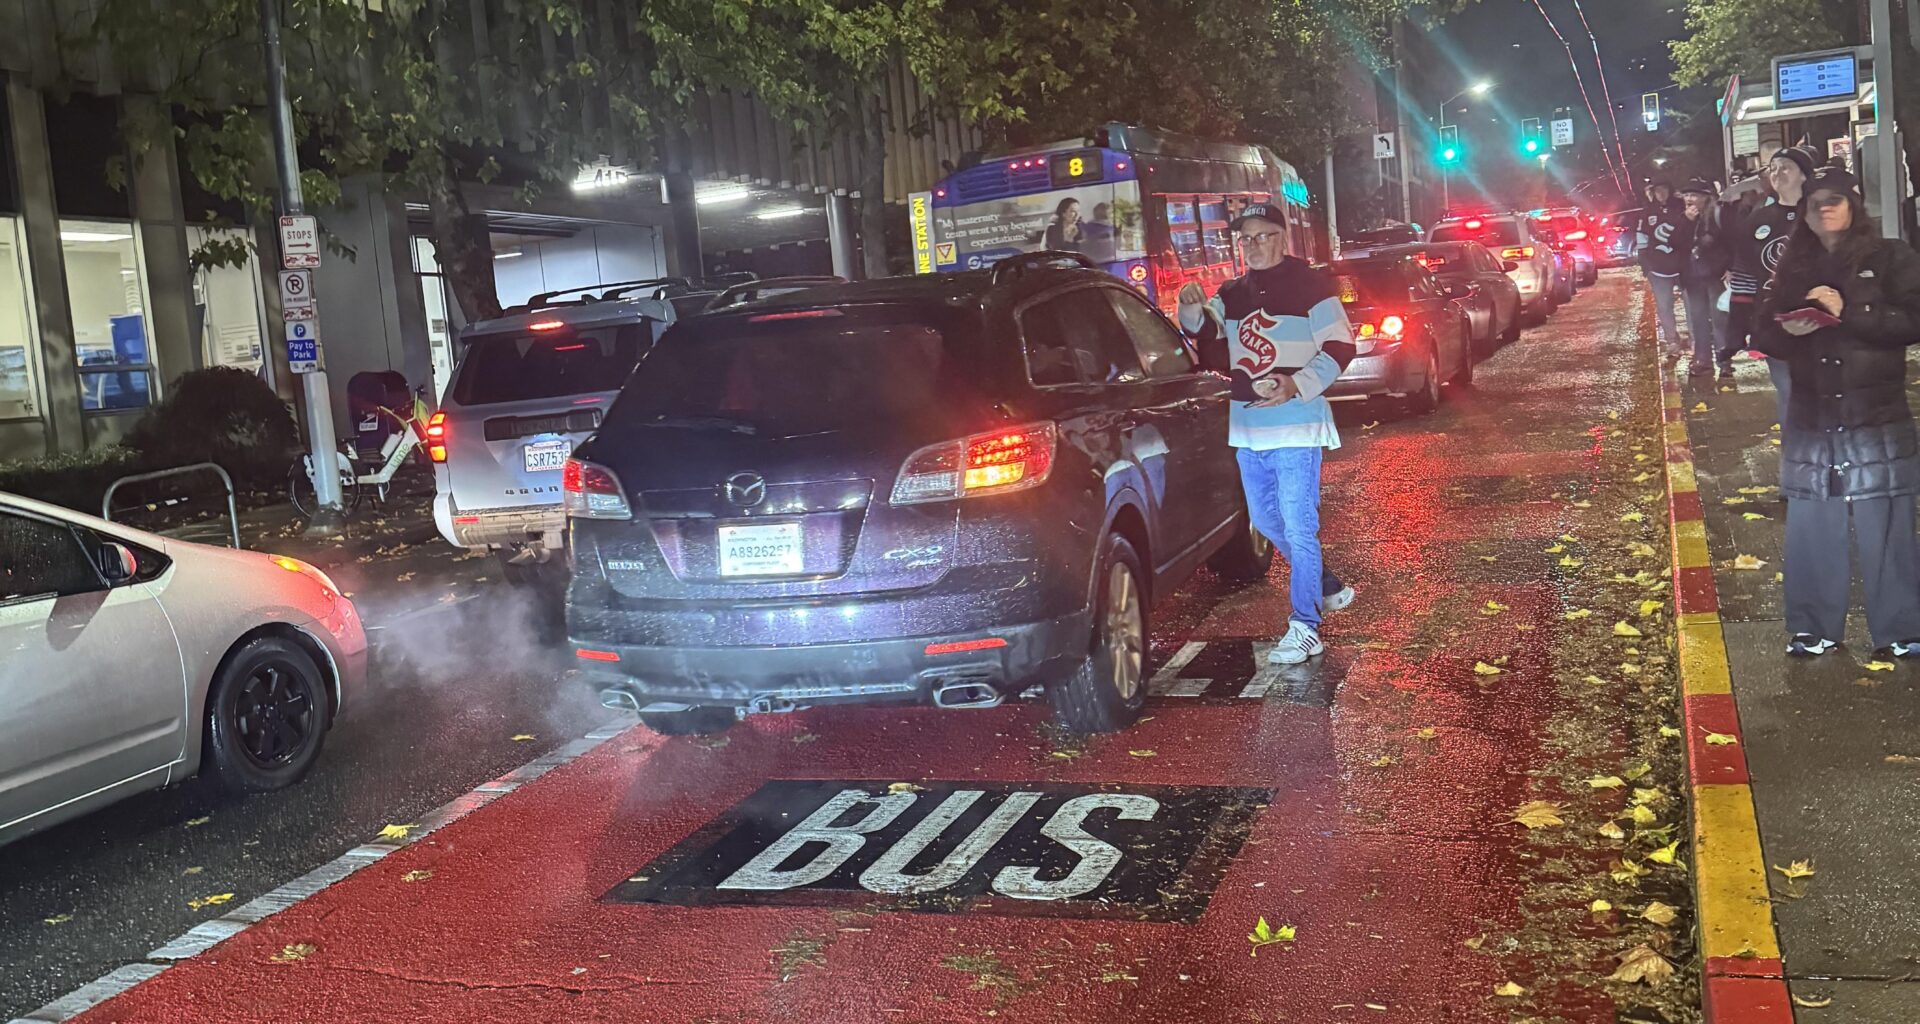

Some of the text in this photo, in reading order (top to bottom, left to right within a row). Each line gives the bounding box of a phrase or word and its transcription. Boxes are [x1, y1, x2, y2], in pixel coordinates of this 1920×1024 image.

[1070, 158, 1083, 176] 8
[282, 218, 293, 226] NO
[913, 197, 929, 250] STATION
[945, 218, 1043, 239] team went way beyond
[287, 230, 312, 240] STOPS
[289, 341, 314, 351] Pay to
[1242, 323, 1272, 364] KRAKEN
[293, 351, 311, 359] Park
[883, 546, 943, 560] CX-9
[716, 788, 1160, 900] BUS
